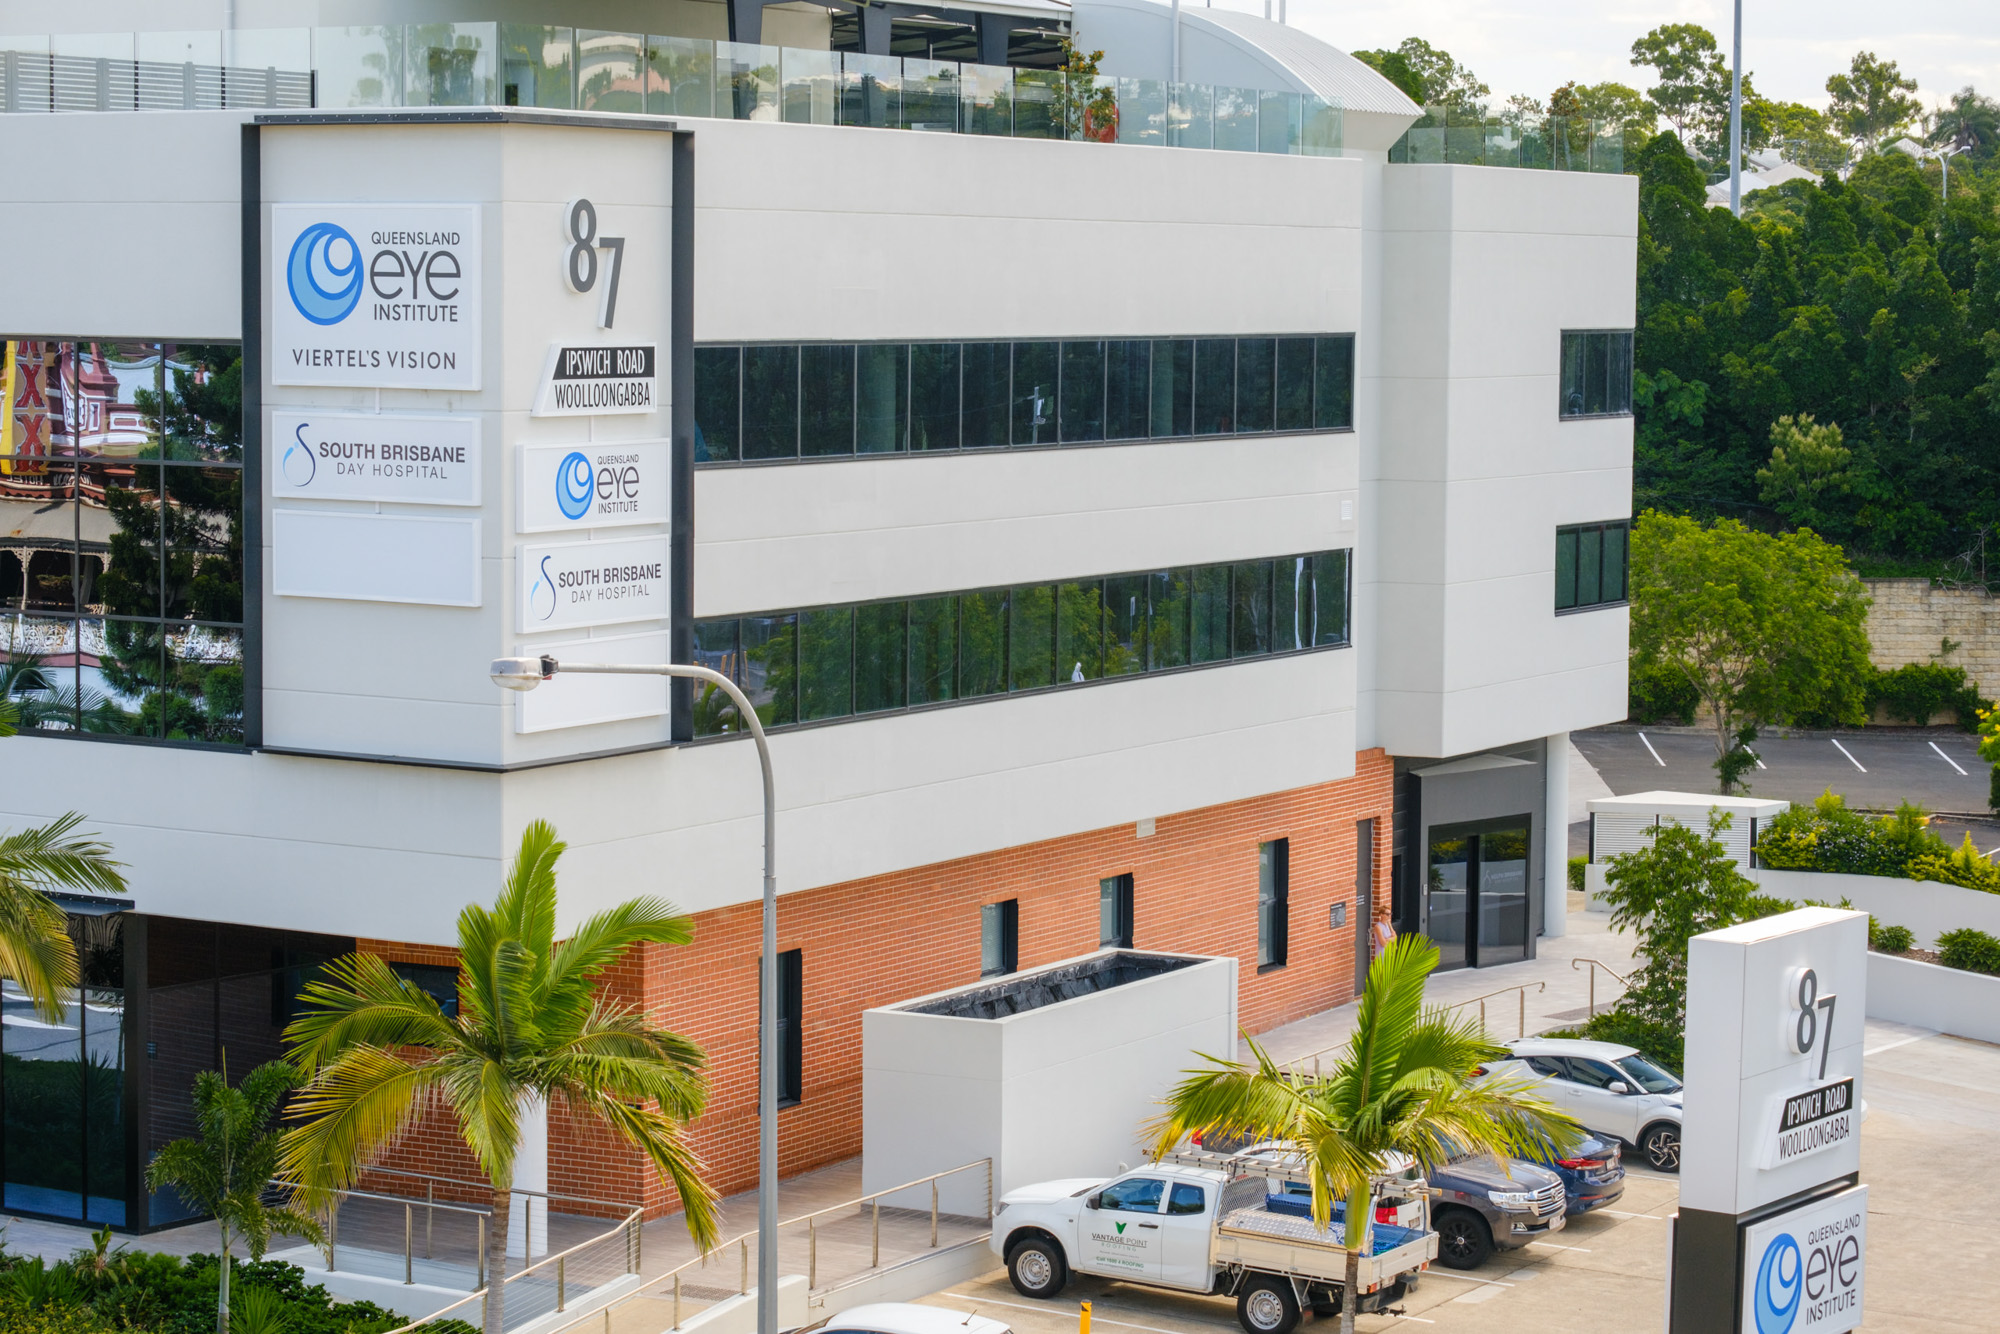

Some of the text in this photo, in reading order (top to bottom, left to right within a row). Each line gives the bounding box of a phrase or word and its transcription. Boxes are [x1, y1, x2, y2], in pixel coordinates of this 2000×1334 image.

[371, 231, 461, 246] QUEENSLAND
[569, 198, 626, 329] 87
[373, 303, 458, 323] INSTITUTE
[292, 348, 456, 370] VIERTEL'S VISION
[566, 349, 645, 375] IPSWICH ROAD
[554, 382, 651, 409] WOOLLOONGABBA
[319, 441, 466, 463] SOUTH BRISBANE
[597, 453, 640, 465] QUEENSLAND
[336, 462, 448, 480] DAY HOSPITAL
[598, 500, 639, 514] INSTITUTE
[558, 563, 662, 589] SOUTH BRISBANE
[571, 584, 650, 604] DAY HOSPITAL
[1797, 968, 1837, 1080] 87
[1787, 1084, 1847, 1126] IPSWICH ROAD
[1779, 1114, 1850, 1160] WOOLLOONGABBA
[1092, 1233, 1148, 1246] VANTAGE POINT
[1808, 1213, 1861, 1246] QUEENSLAND
[1101, 1242, 1136, 1251] ROOFING
[1806, 1288, 1856, 1325] INSTITUTE
